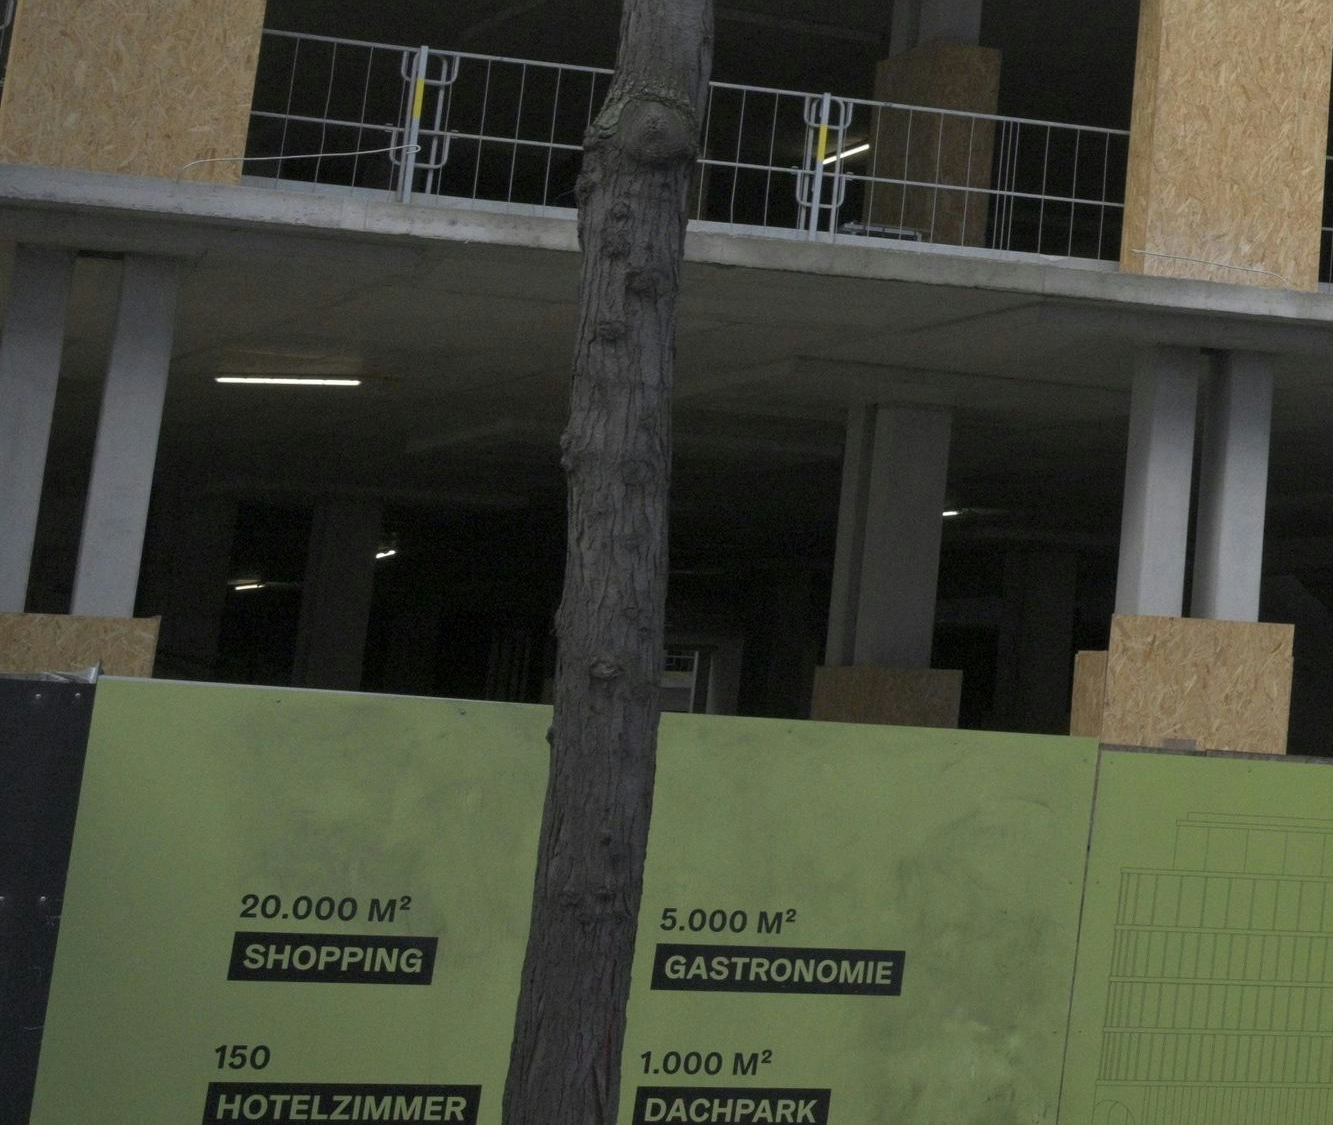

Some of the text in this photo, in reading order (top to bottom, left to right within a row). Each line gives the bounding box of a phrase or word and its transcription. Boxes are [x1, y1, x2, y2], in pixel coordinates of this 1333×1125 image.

[240, 894, 358, 921] 20.000
[660, 908, 748, 933] 5.000
[243, 943, 423, 973] SHOPPING
[664, 955, 893, 985] GASTRONOMIE
[215, 1045, 271, 1069] 150
[641, 1051, 723, 1074] 1.000
[216, 1094, 467, 1121] HOTELZIMMER
[644, 1097, 818, 1123] DACHPARK
